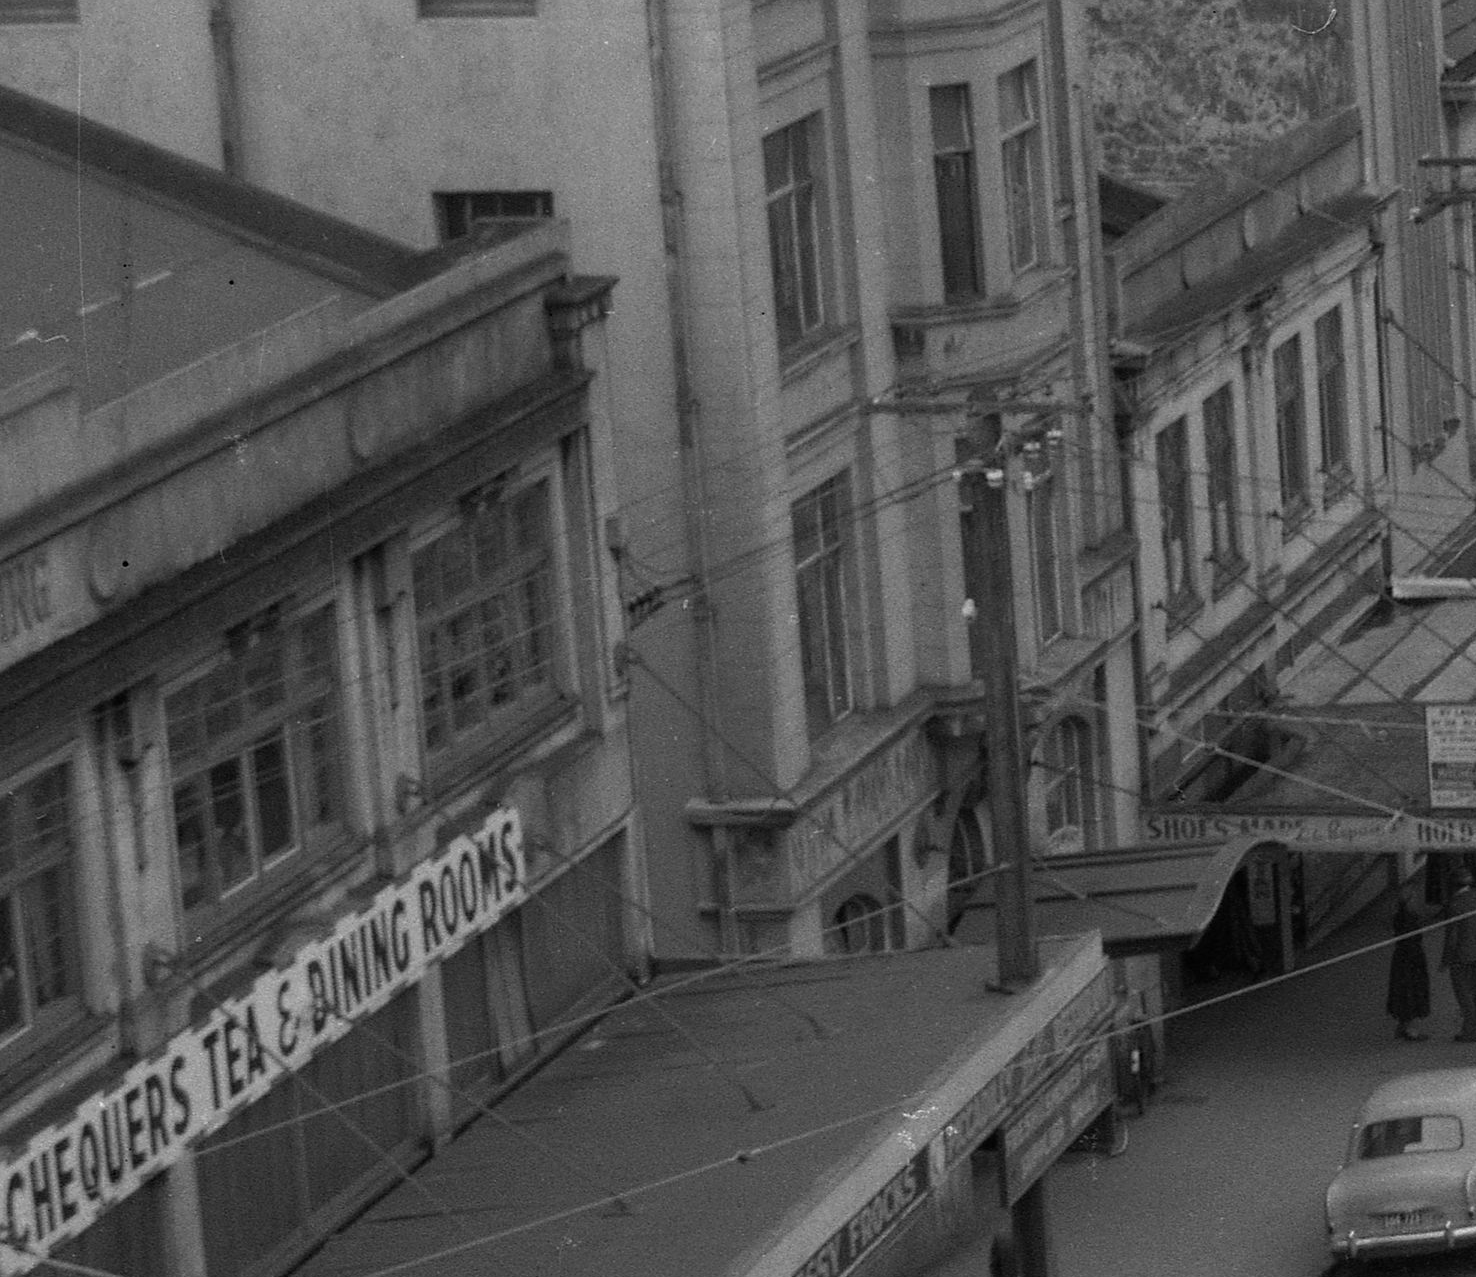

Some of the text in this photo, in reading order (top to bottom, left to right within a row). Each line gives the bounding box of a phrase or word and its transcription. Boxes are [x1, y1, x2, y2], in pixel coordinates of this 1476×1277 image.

[5, 1051, 191, 1247] CHEQUERS
[203, 1002, 267, 1112] TEA
[307, 898, 411, 1036] DINING
[418, 820, 519, 956] ROOMS
